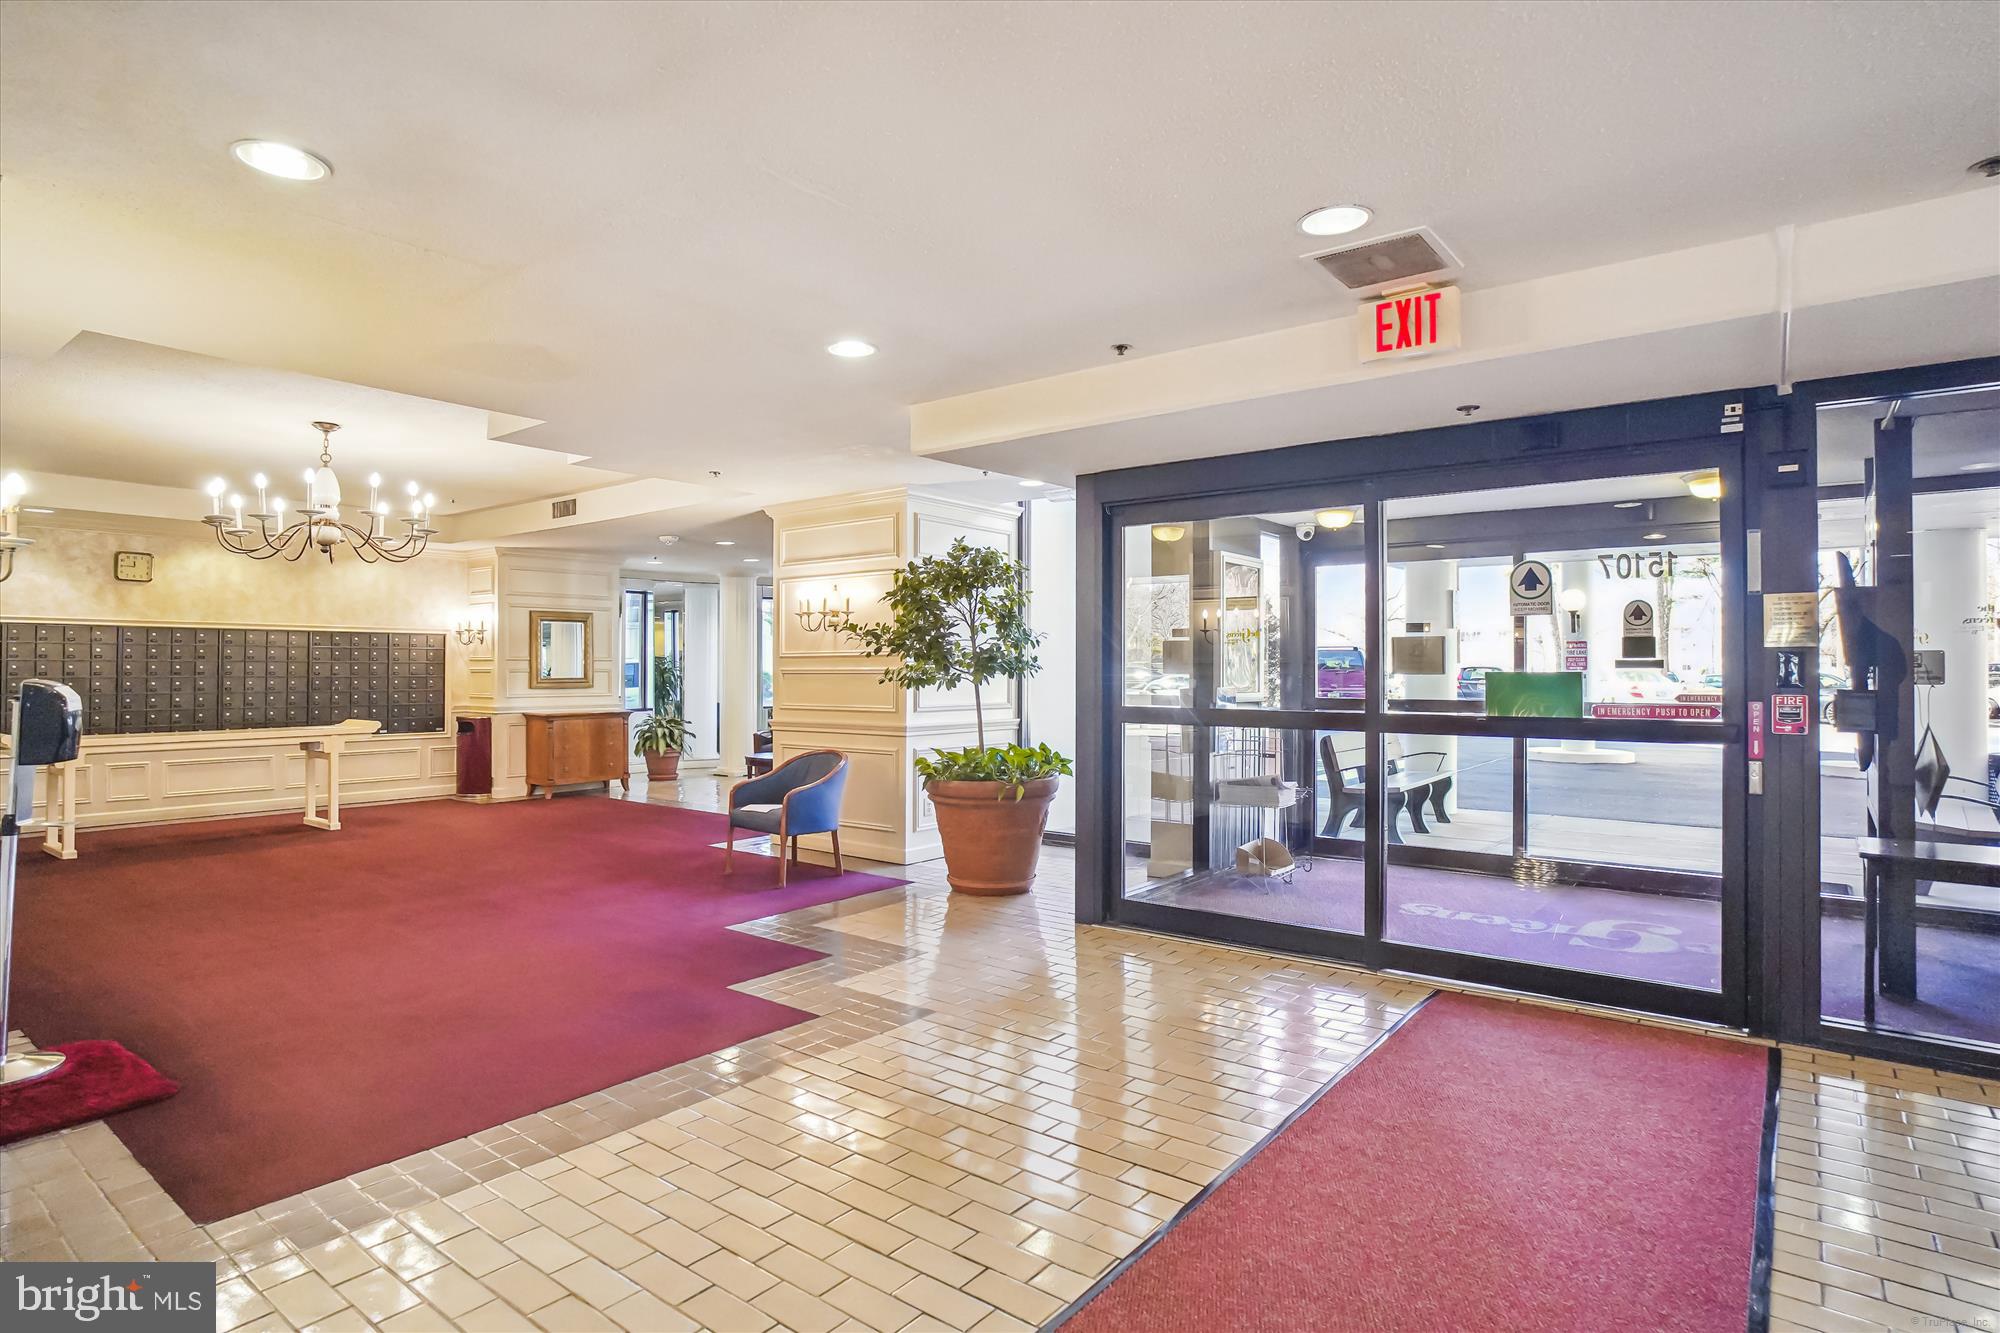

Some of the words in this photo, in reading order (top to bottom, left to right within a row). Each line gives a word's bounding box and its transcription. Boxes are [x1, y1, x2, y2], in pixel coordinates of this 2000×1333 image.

[1376, 293, 1441, 352] EXIT
[1776, 696, 1804, 705] FIRE
[1597, 707, 1605, 716] IN
[1607, 707, 1651, 716] EMERGENCY
[1655, 708, 1676, 717] PUSH
[1679, 708, 1688, 717] TO
[1690, 708, 1711, 717] OPEN
[1752, 703, 1761, 733] OPEN
